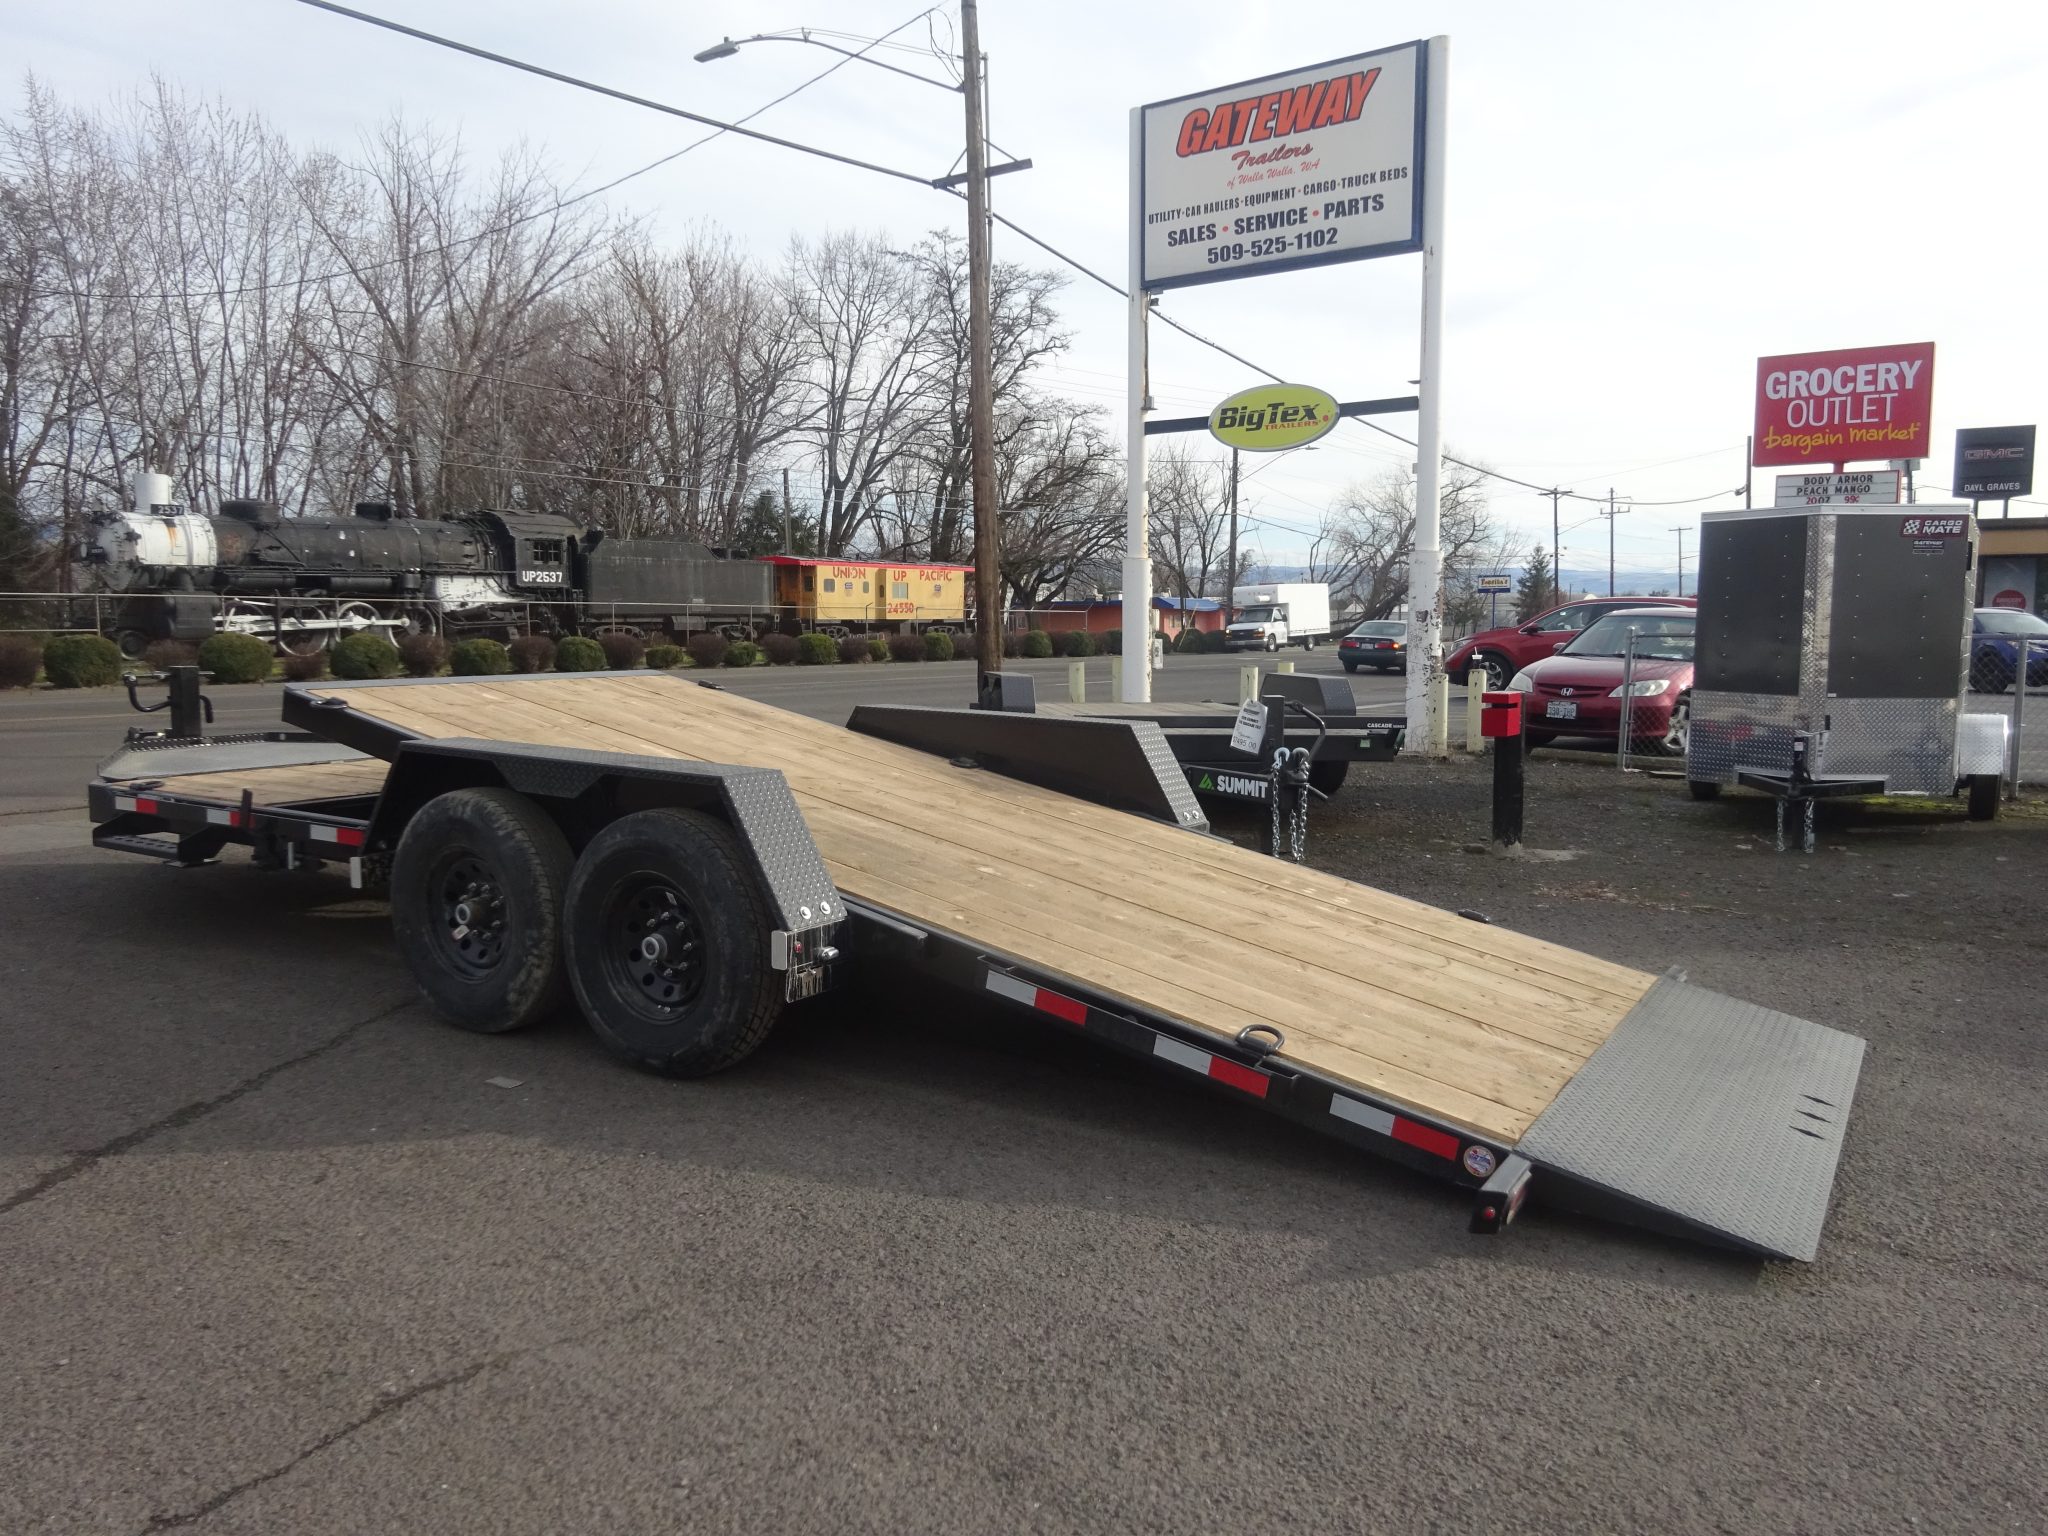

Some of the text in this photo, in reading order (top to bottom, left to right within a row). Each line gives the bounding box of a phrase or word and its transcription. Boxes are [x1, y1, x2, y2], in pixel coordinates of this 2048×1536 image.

[1175, 67, 1382, 158] GATEWAY
[1231, 143, 1313, 170] Trailers
[1227, 176, 1236, 189] of
[1238, 171, 1264, 185] Walla
[1300, 158, 1320, 172] WA
[1379, 166, 1408, 183] BEDS
[1167, 193, 1385, 247] SALES SERVICE PARTS
[1207, 227, 1338, 265] 509-525-1102
[1765, 360, 1924, 400] GROCERY
[1786, 393, 1899, 428] OUTLET
[1265, 418, 1320, 431] TRAILERS
[1763, 422, 1921, 454] bargain market
[1964, 447, 2025, 460] GMC
[1804, 474, 1873, 486] BODY ARMOR
[1964, 482, 2020, 492] DAYL GRAVES
[1796, 484, 1871, 496] PEACH MANGO
[157, 505, 183, 515] 2537
[1922, 525, 1962, 534] MATE
[522, 570, 563, 583] UP2537
[832, 566, 953, 582] UNION UP PACIFIC
[1217, 775, 1268, 799] SUMMIT
